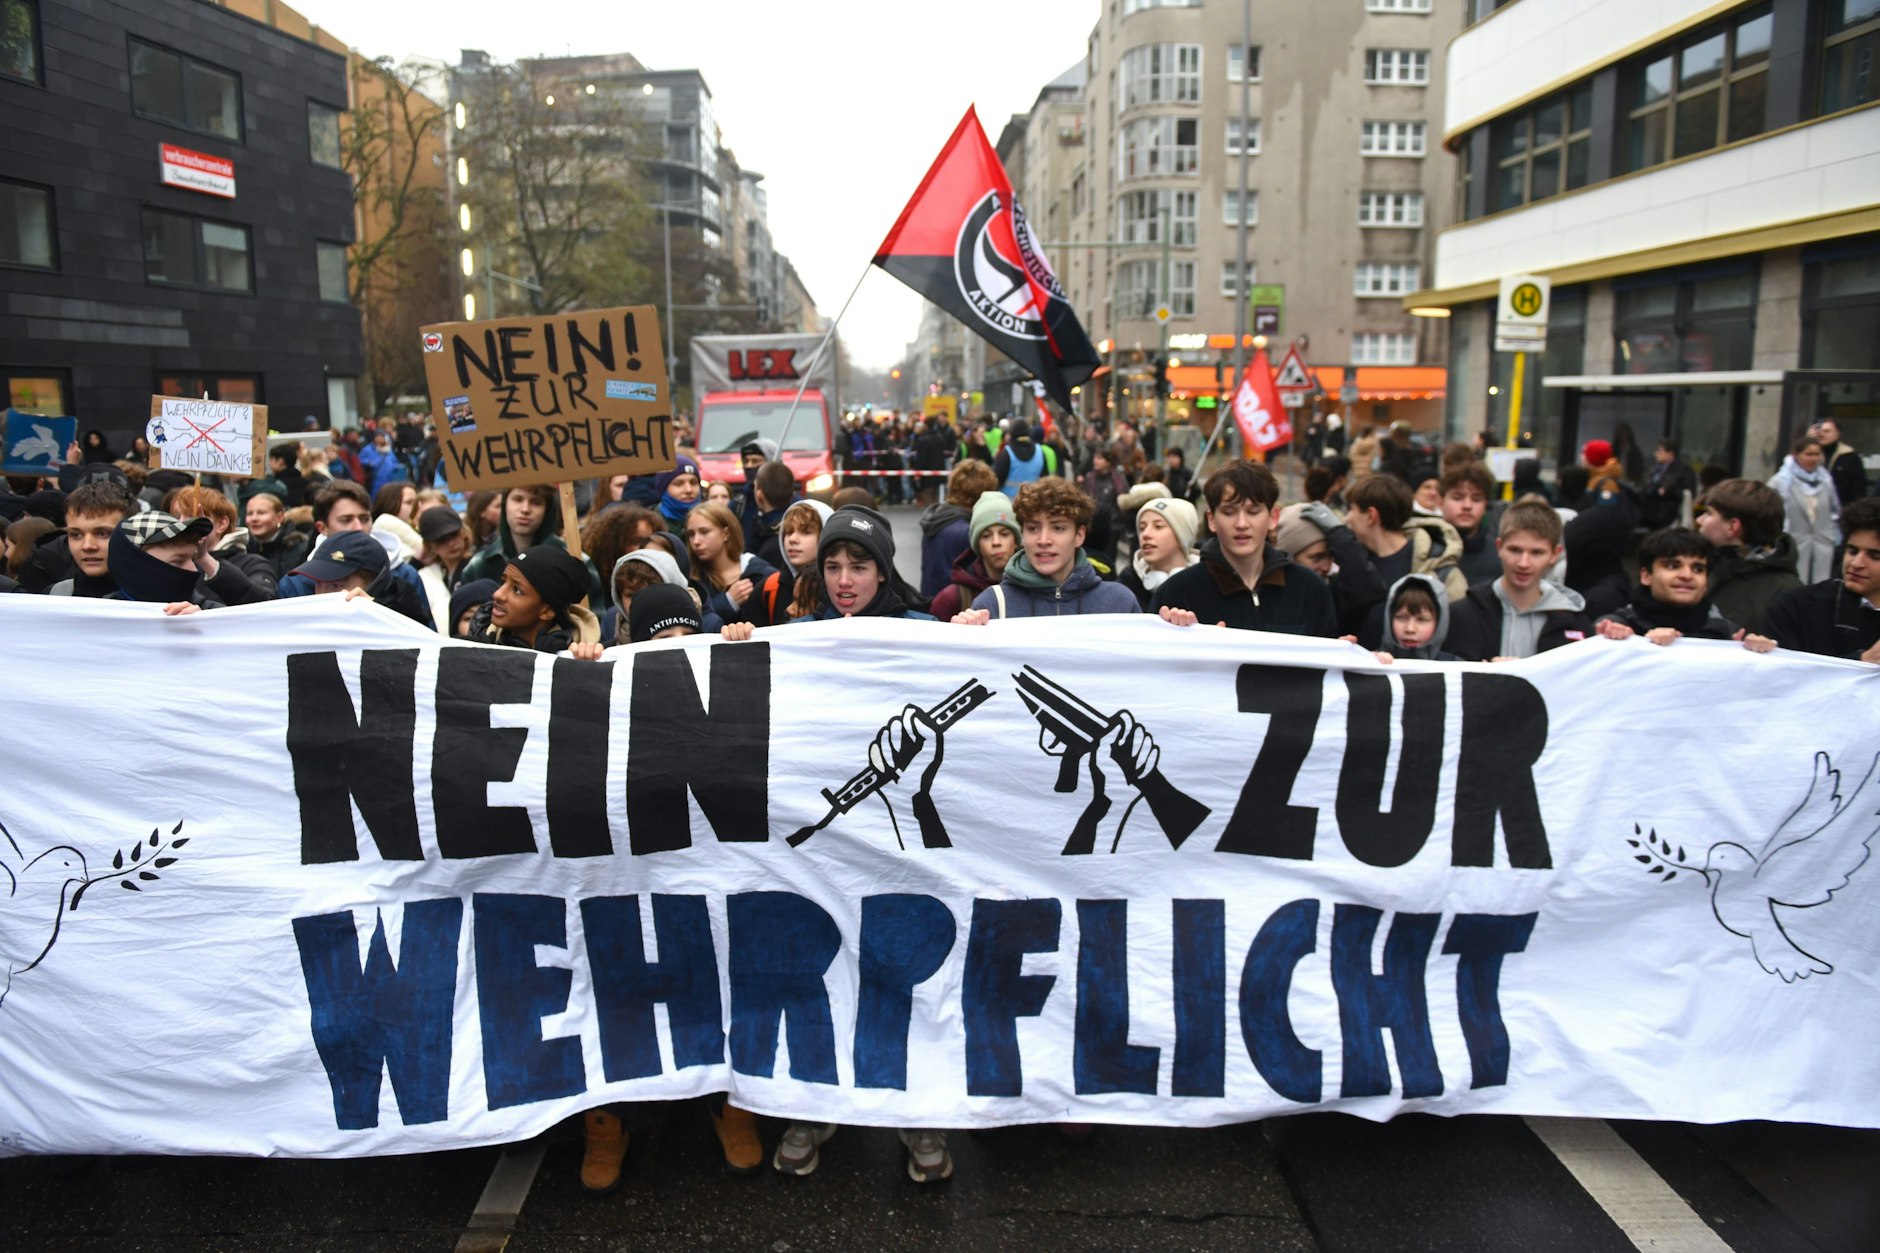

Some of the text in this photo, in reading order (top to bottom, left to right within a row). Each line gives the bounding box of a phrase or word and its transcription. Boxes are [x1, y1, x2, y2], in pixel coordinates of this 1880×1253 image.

[968, 289, 1026, 332] AKTION
[452, 312, 642, 388] NEIN!
[728, 349, 800, 381] LEX
[490, 371, 598, 419] ZUR
[165, 448, 200, 468] NEIN
[446, 415, 671, 480] WEHRPFLICHT
[286, 641, 1553, 870] NEIN ZUR
[292, 891, 1539, 1131] WEHRPFLICHT
